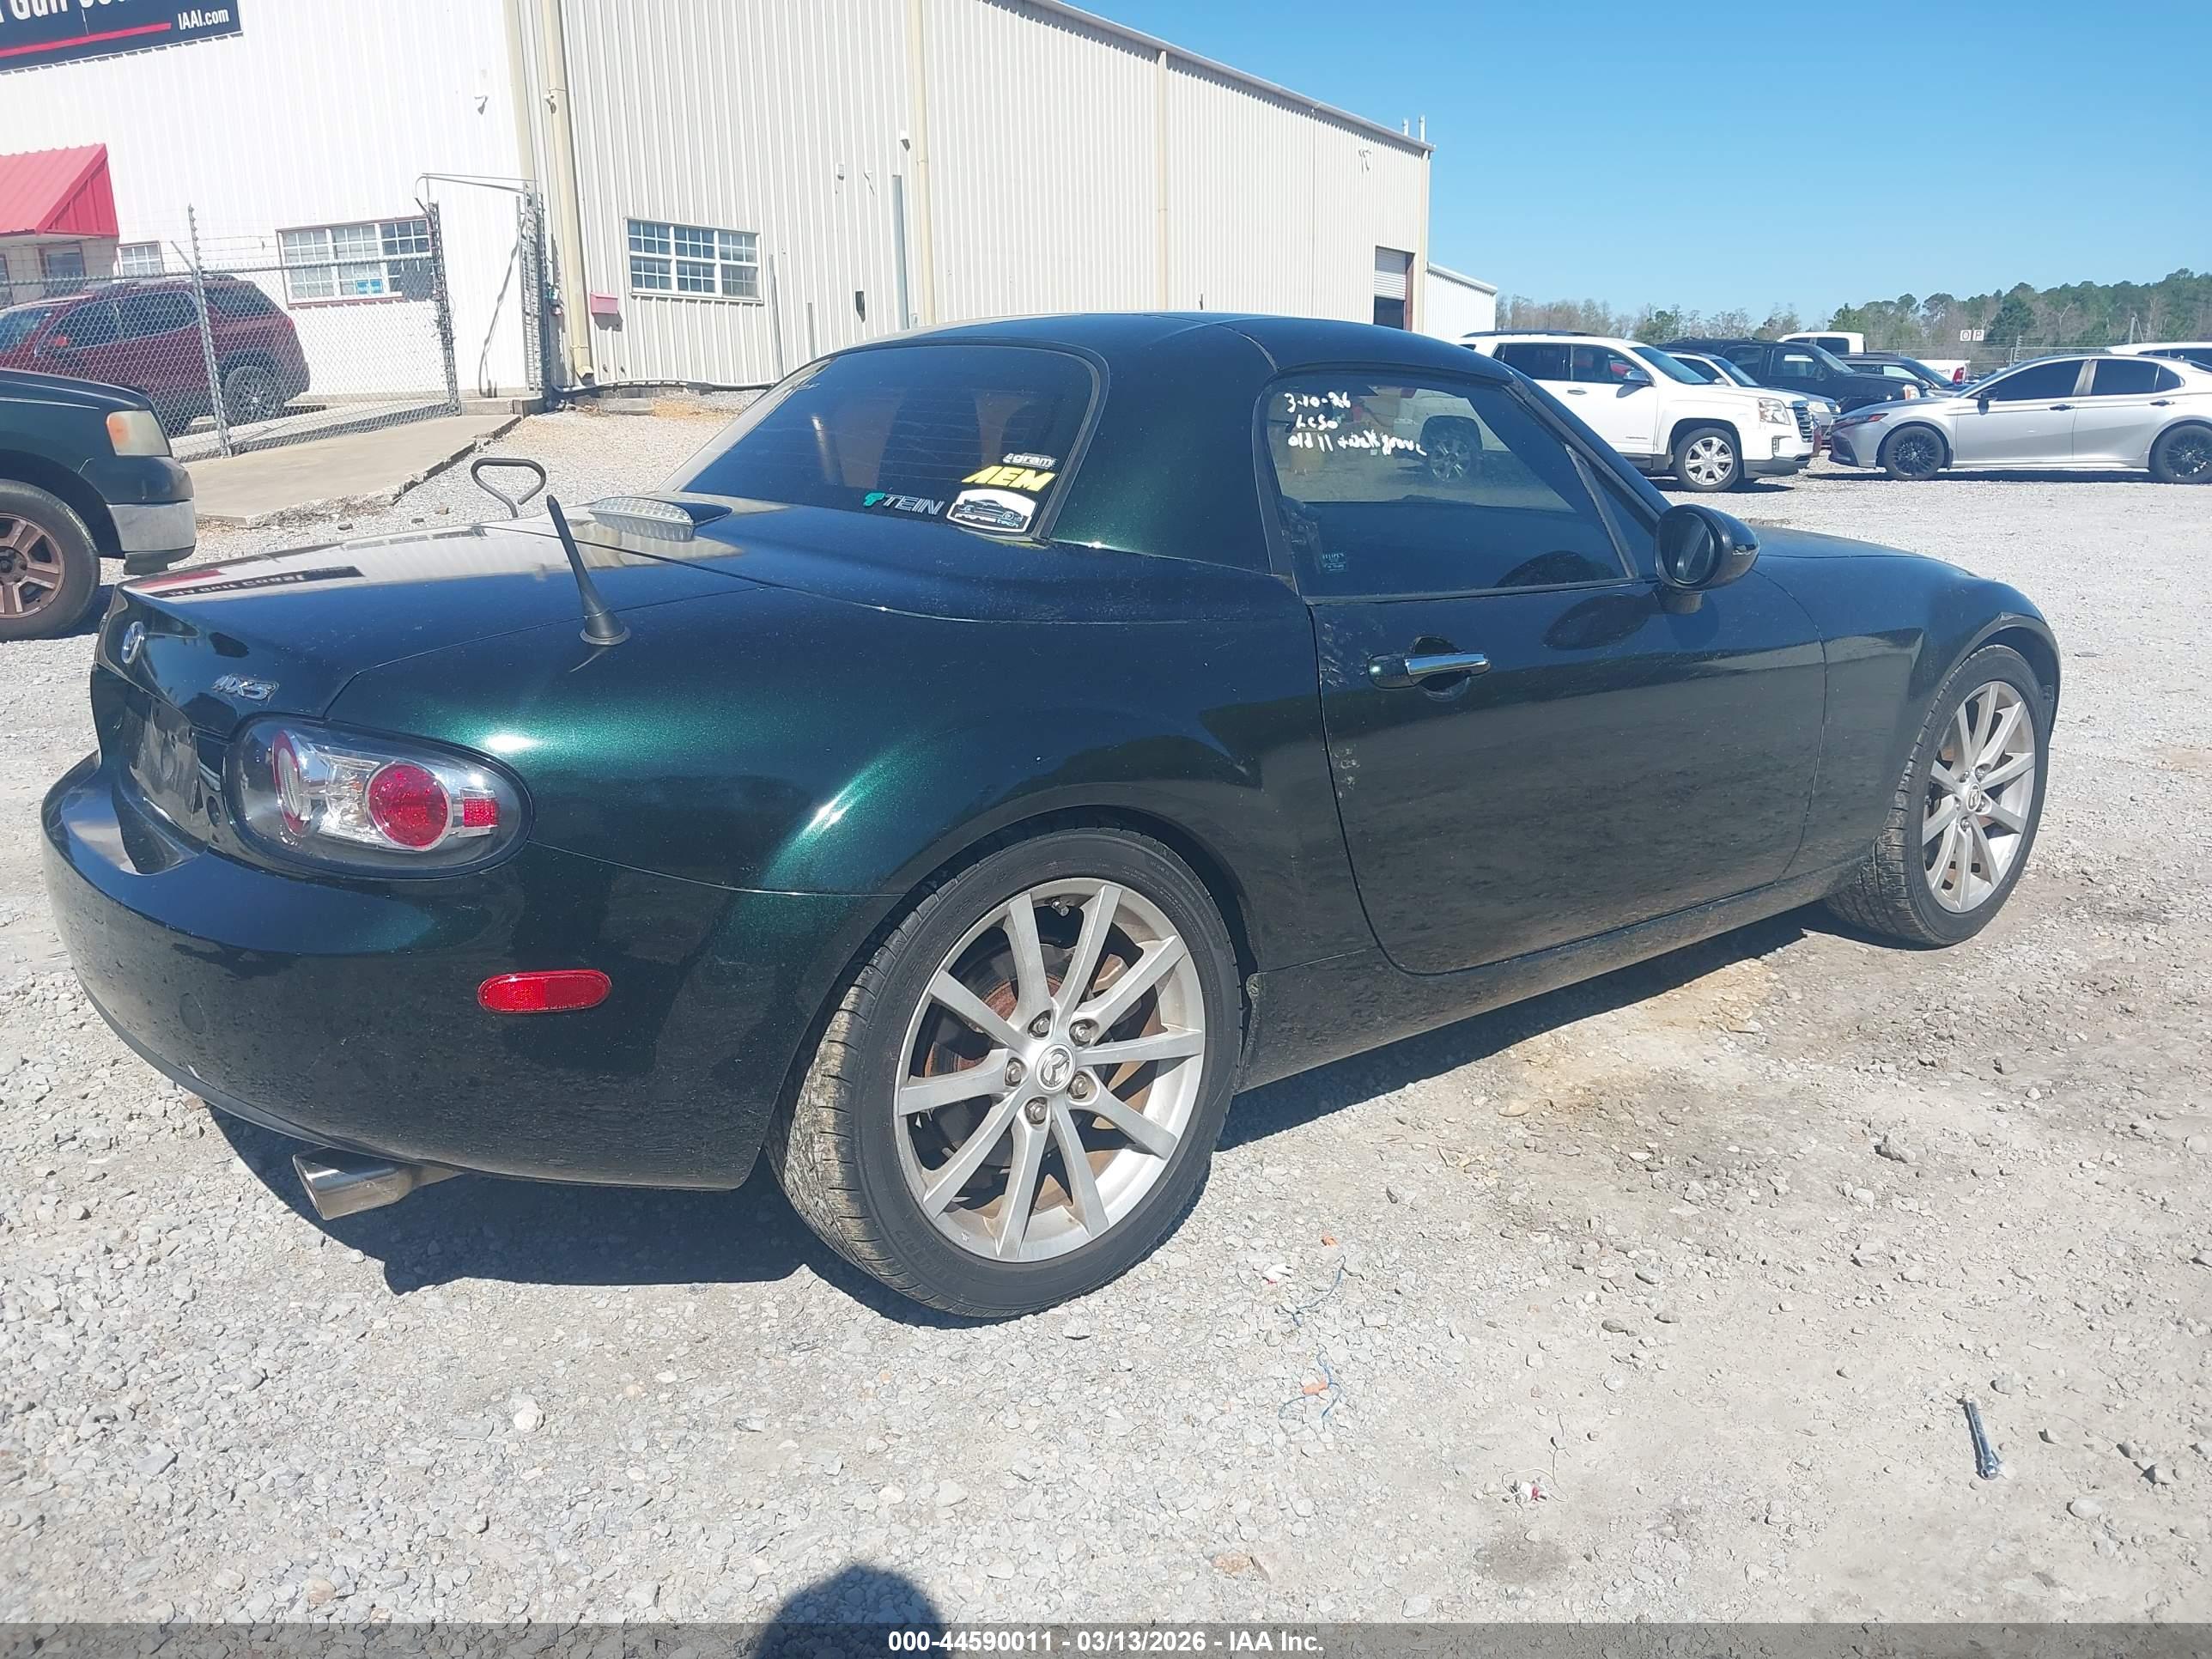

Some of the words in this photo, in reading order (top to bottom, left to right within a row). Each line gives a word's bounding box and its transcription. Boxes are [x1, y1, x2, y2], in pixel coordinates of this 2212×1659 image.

[178, 9, 229, 31] IAAI.com
[1975, 330, 1982, 339] P
[962, 465, 1057, 492] AEM
[883, 494, 945, 515] TEIN
